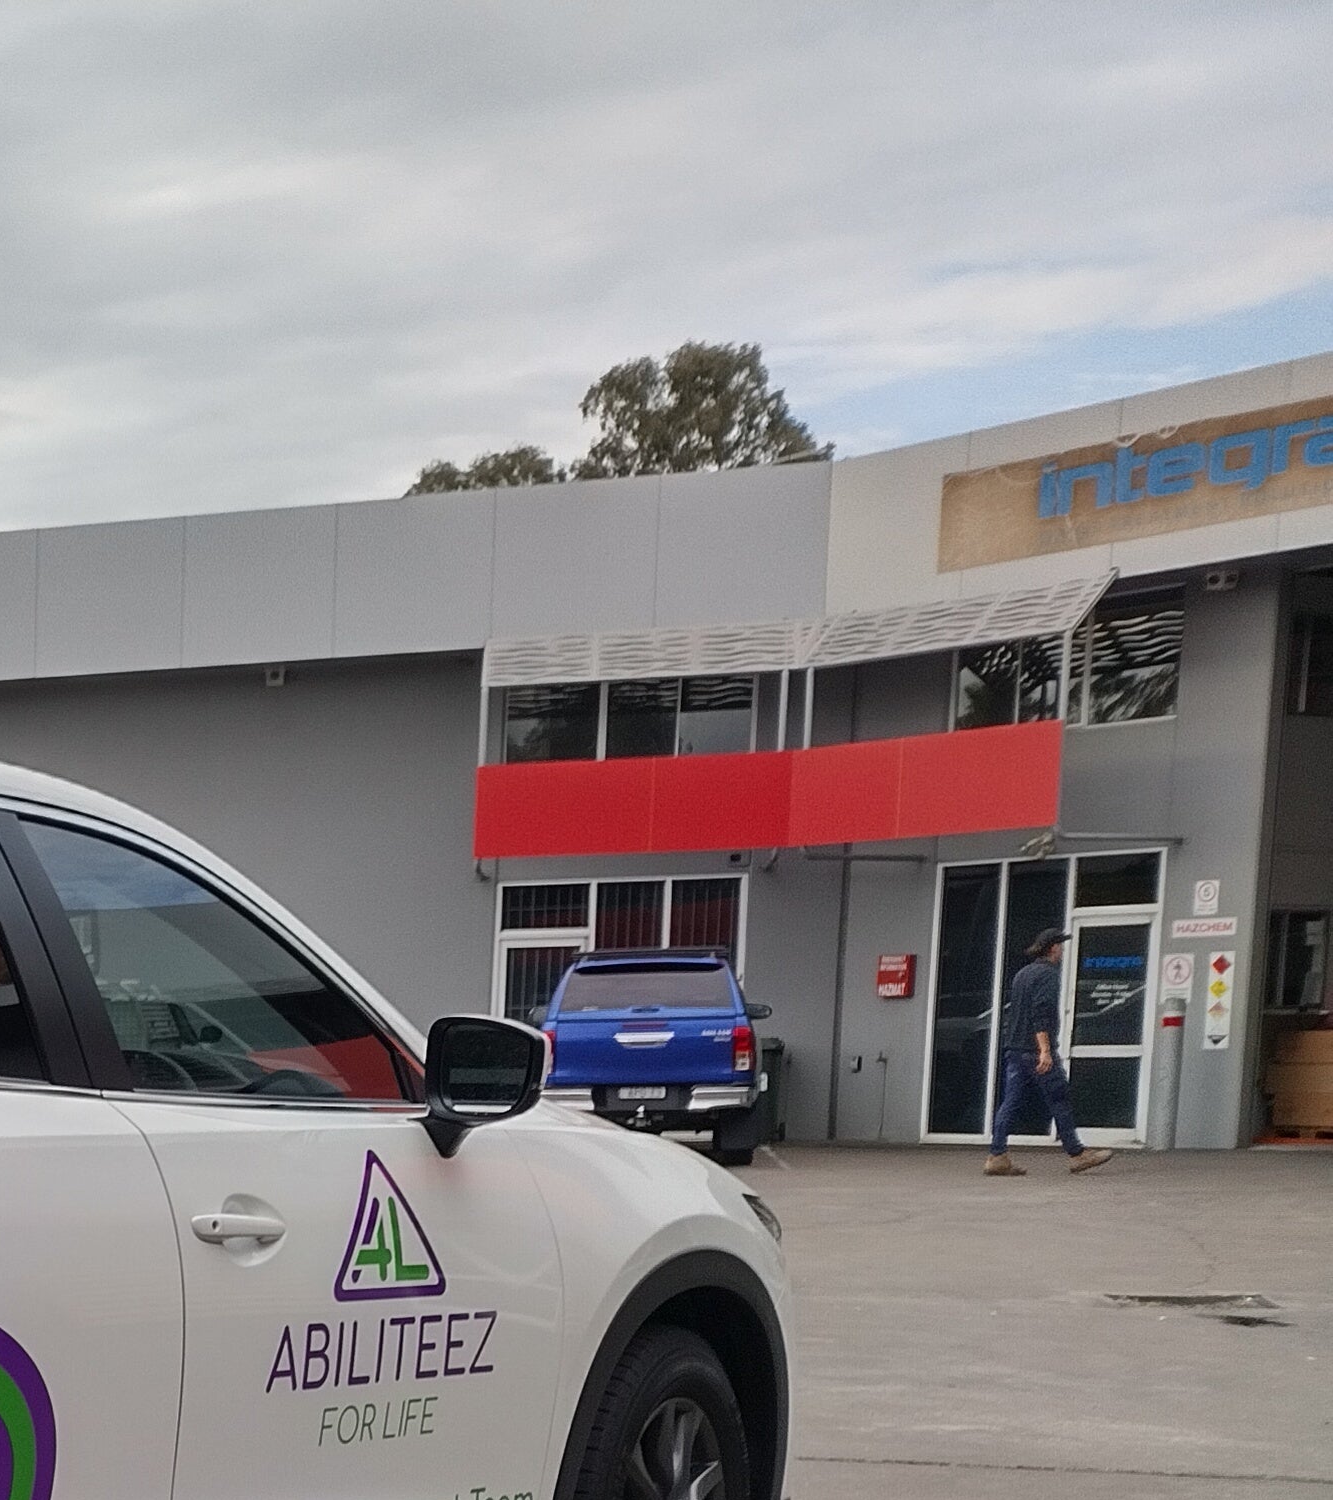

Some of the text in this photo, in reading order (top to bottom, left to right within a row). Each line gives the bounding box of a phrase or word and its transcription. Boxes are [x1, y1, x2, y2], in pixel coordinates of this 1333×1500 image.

[1175, 920, 1233, 934] HAZCHEM
[265, 1309, 498, 1394] ABILITEEZ
[318, 1397, 439, 1448] FOR LIFE
